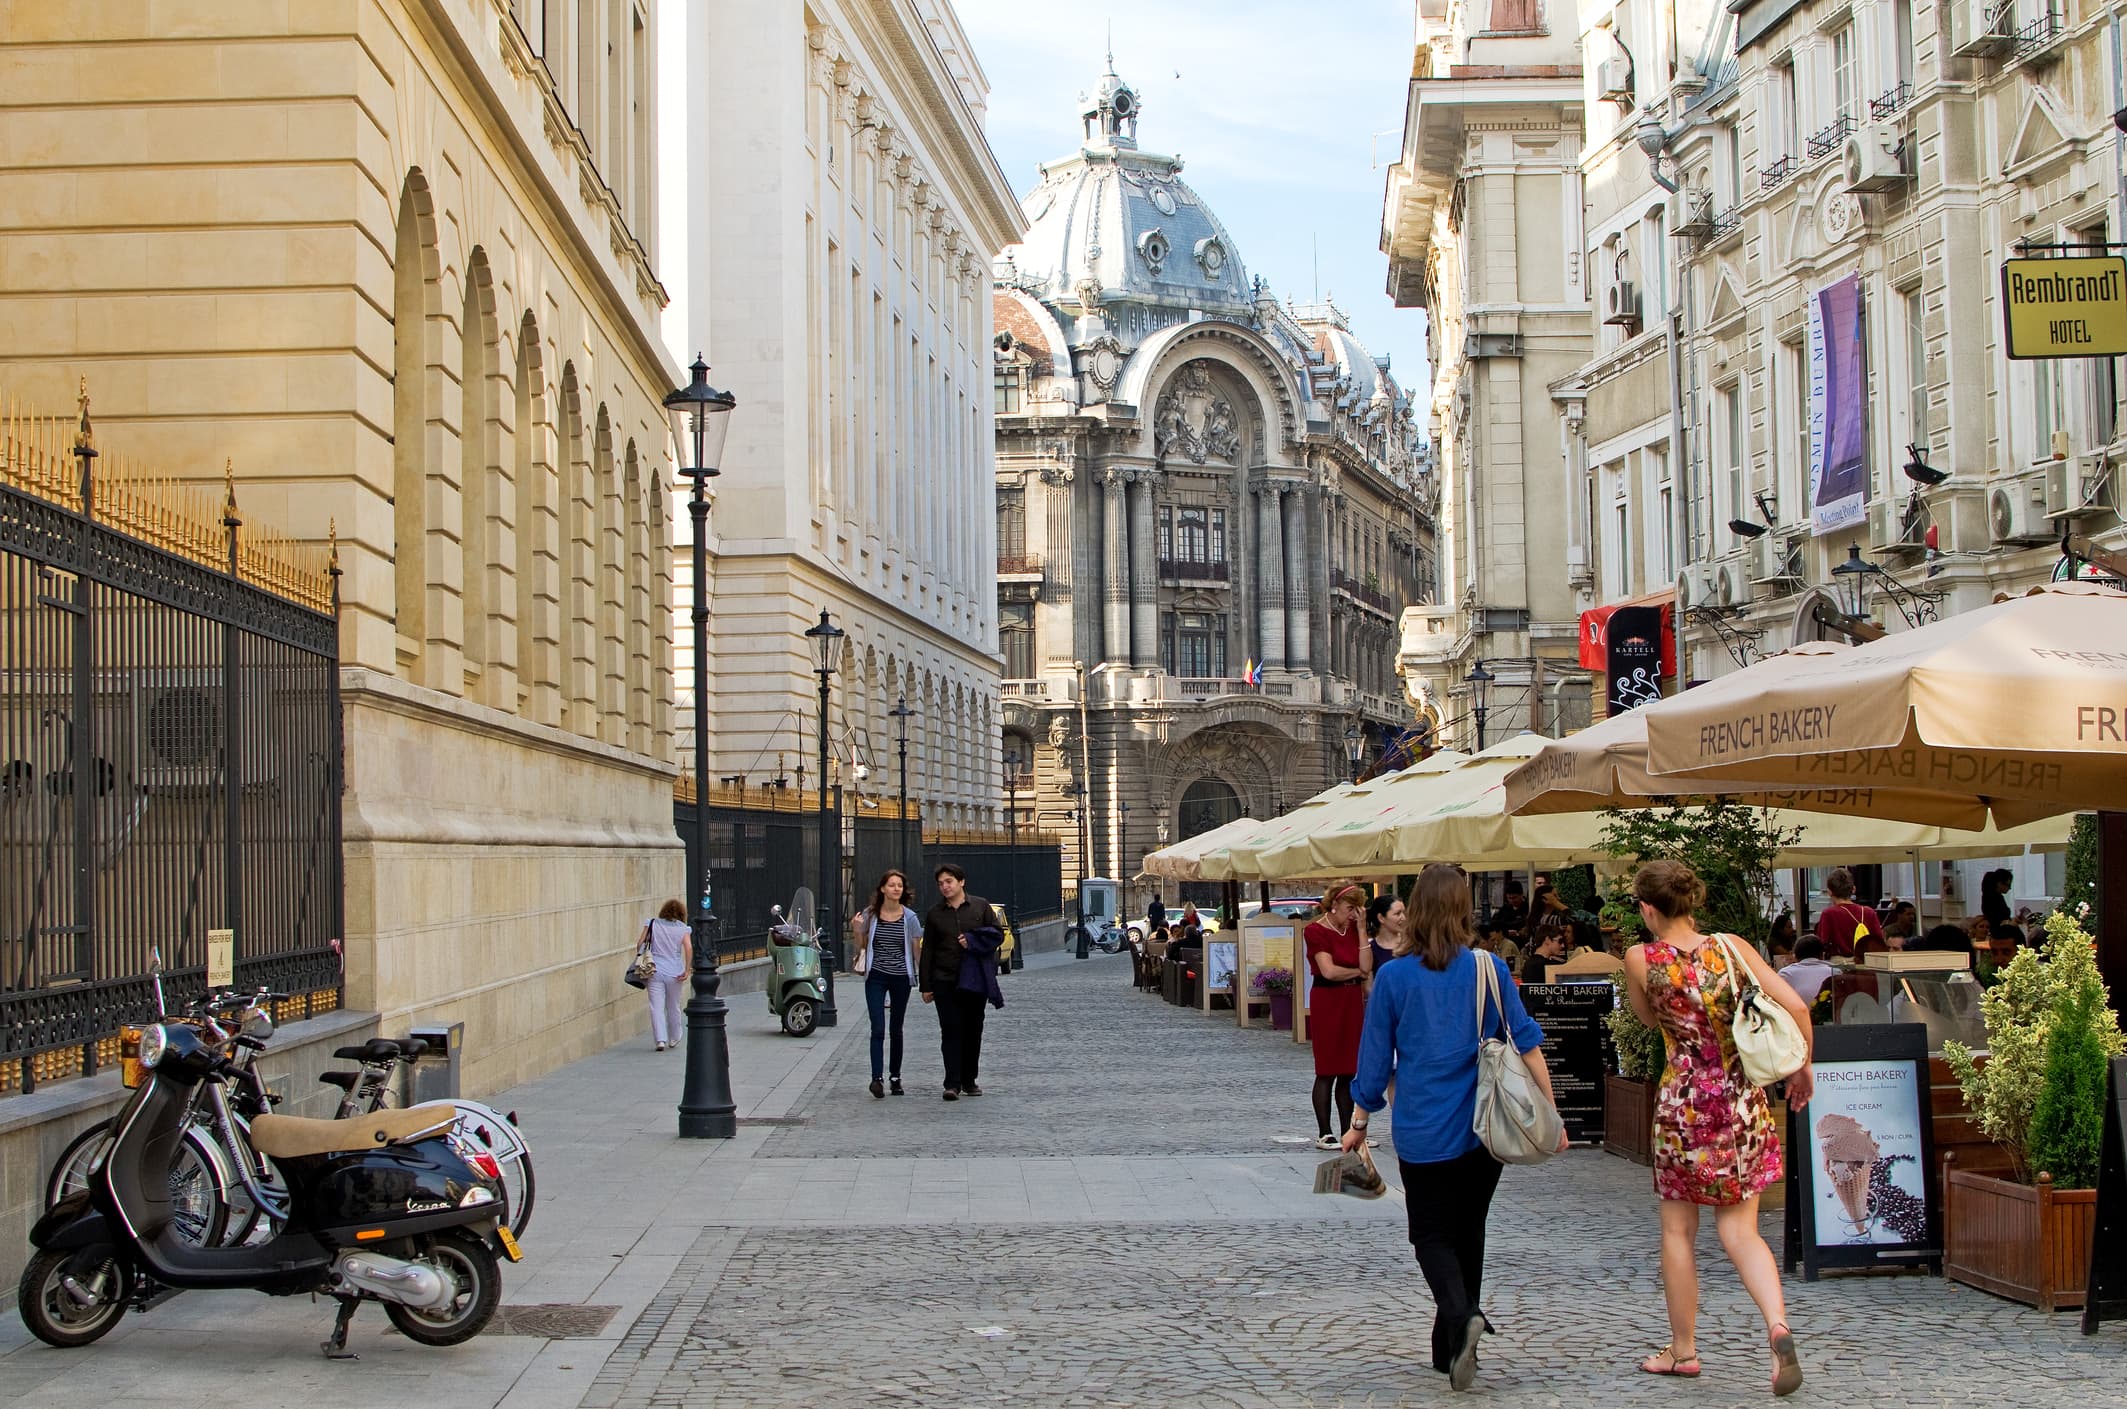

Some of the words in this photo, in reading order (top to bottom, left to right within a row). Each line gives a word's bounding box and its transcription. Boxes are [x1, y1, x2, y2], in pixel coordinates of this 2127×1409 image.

[2049, 320, 2092, 344] HOTEL
[1700, 714, 1764, 757] FRENCH
[1770, 704, 1837, 744] BAKERY
[1549, 752, 1578, 780] BAKERY
[1528, 986, 1568, 995] FRENCH
[1573, 986, 1609, 995] BAKERY
[1544, 995, 1554, 1005] Le
[1557, 995, 1595, 1005] Restaurant
[1816, 1071, 1863, 1082] FRENCH
[1866, 1070, 1908, 1081] BAKERY
[406, 1197, 451, 1213] Vespa
